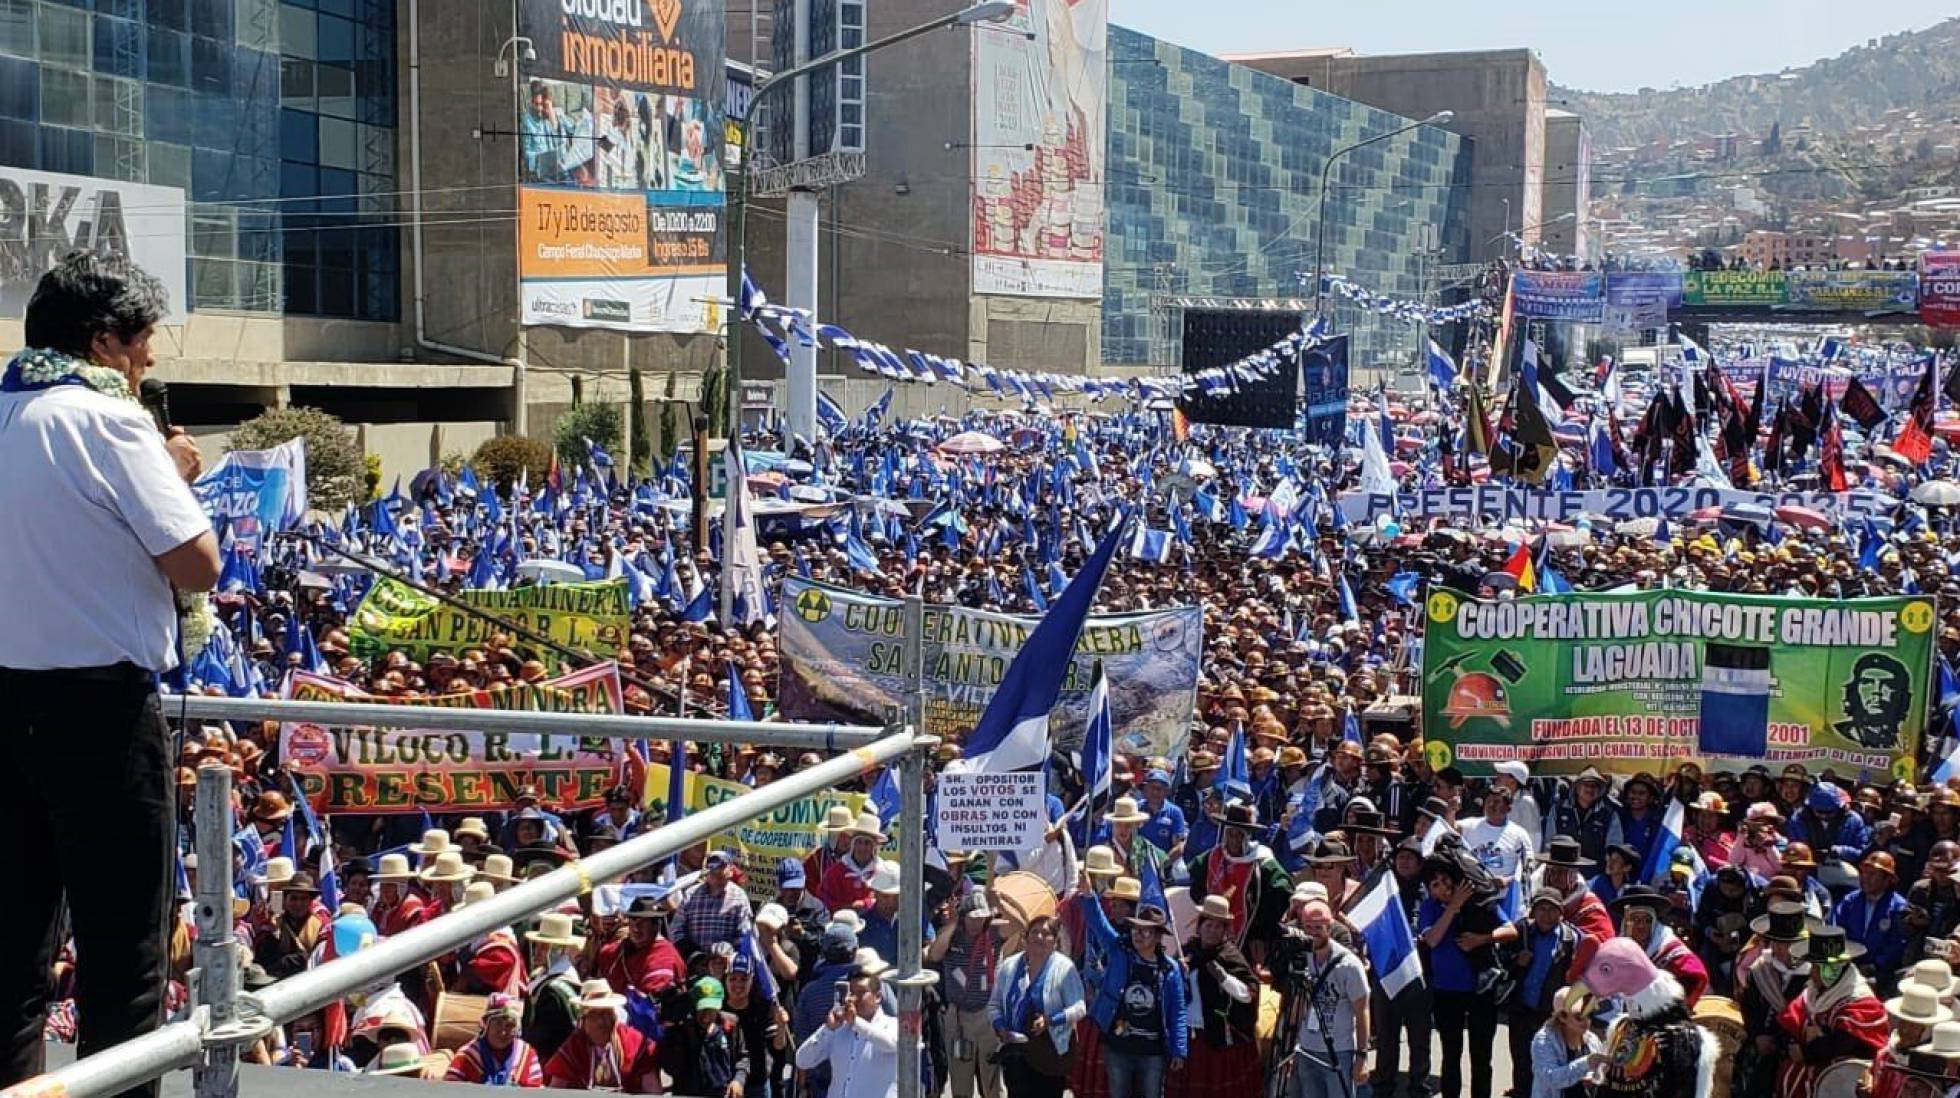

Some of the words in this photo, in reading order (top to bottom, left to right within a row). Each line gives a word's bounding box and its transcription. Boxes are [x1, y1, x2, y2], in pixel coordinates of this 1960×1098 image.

[563, 16, 695, 90] inmobiliaria
[537, 203, 552, 231] 17
[554, 209, 562, 239] y
[564, 204, 579, 231] 18
[581, 206, 596, 233] de
[599, 209, 640, 240] agosto
[652, 212, 667, 232] De
[1368, 487, 1583, 522] PRESENTE
[1606, 487, 1720, 520] 2020
[845, 602, 1027, 651] COOERATIVA
[1457, 602, 1649, 639] COOPERATIVA
[1654, 598, 1777, 642] CHICOTE
[1781, 608, 1898, 647] GRANDE
[868, 641, 925, 676] SA
[935, 651, 1004, 686] ANTO
[1573, 642, 1697, 683] LAGUADA
[1533, 718, 1601, 739] FUNDADA
[1604, 718, 1620, 736] EL
[1625, 716, 1642, 736] 13
[1646, 717, 1665, 736] DE
[1768, 724, 1809, 744] 2001
[330, 727, 470, 765] VILOCO
[484, 731, 521, 763] R.
[536, 733, 574, 761] L.
[1457, 745, 1514, 759] PROVINCIA
[1571, 744, 1584, 757] DE
[1588, 745, 1600, 757] LA
[1603, 743, 1647, 757] CUARTA
[1831, 750, 1844, 760] DE
[1850, 752, 1863, 763] LA
[1867, 755, 1889, 768] PAZ
[300, 766, 615, 808] PRESENTE
[943, 786, 967, 797] LOS
[970, 785, 1016, 796] VOTOS
[1022, 786, 1037, 795] SE
[945, 775, 965, 784] SR.
[976, 774, 1035, 785] OPOSITOR
[941, 810, 987, 821] OBRAS
[992, 810, 1009, 820] NO
[1013, 810, 1038, 820] CON
[950, 798, 992, 808] GANAN
[999, 798, 1024, 808] CON
[950, 823, 1008, 834] INSULTOS
[1014, 821, 1027, 832] NI
[961, 836, 1023, 846] MENTIRAS
